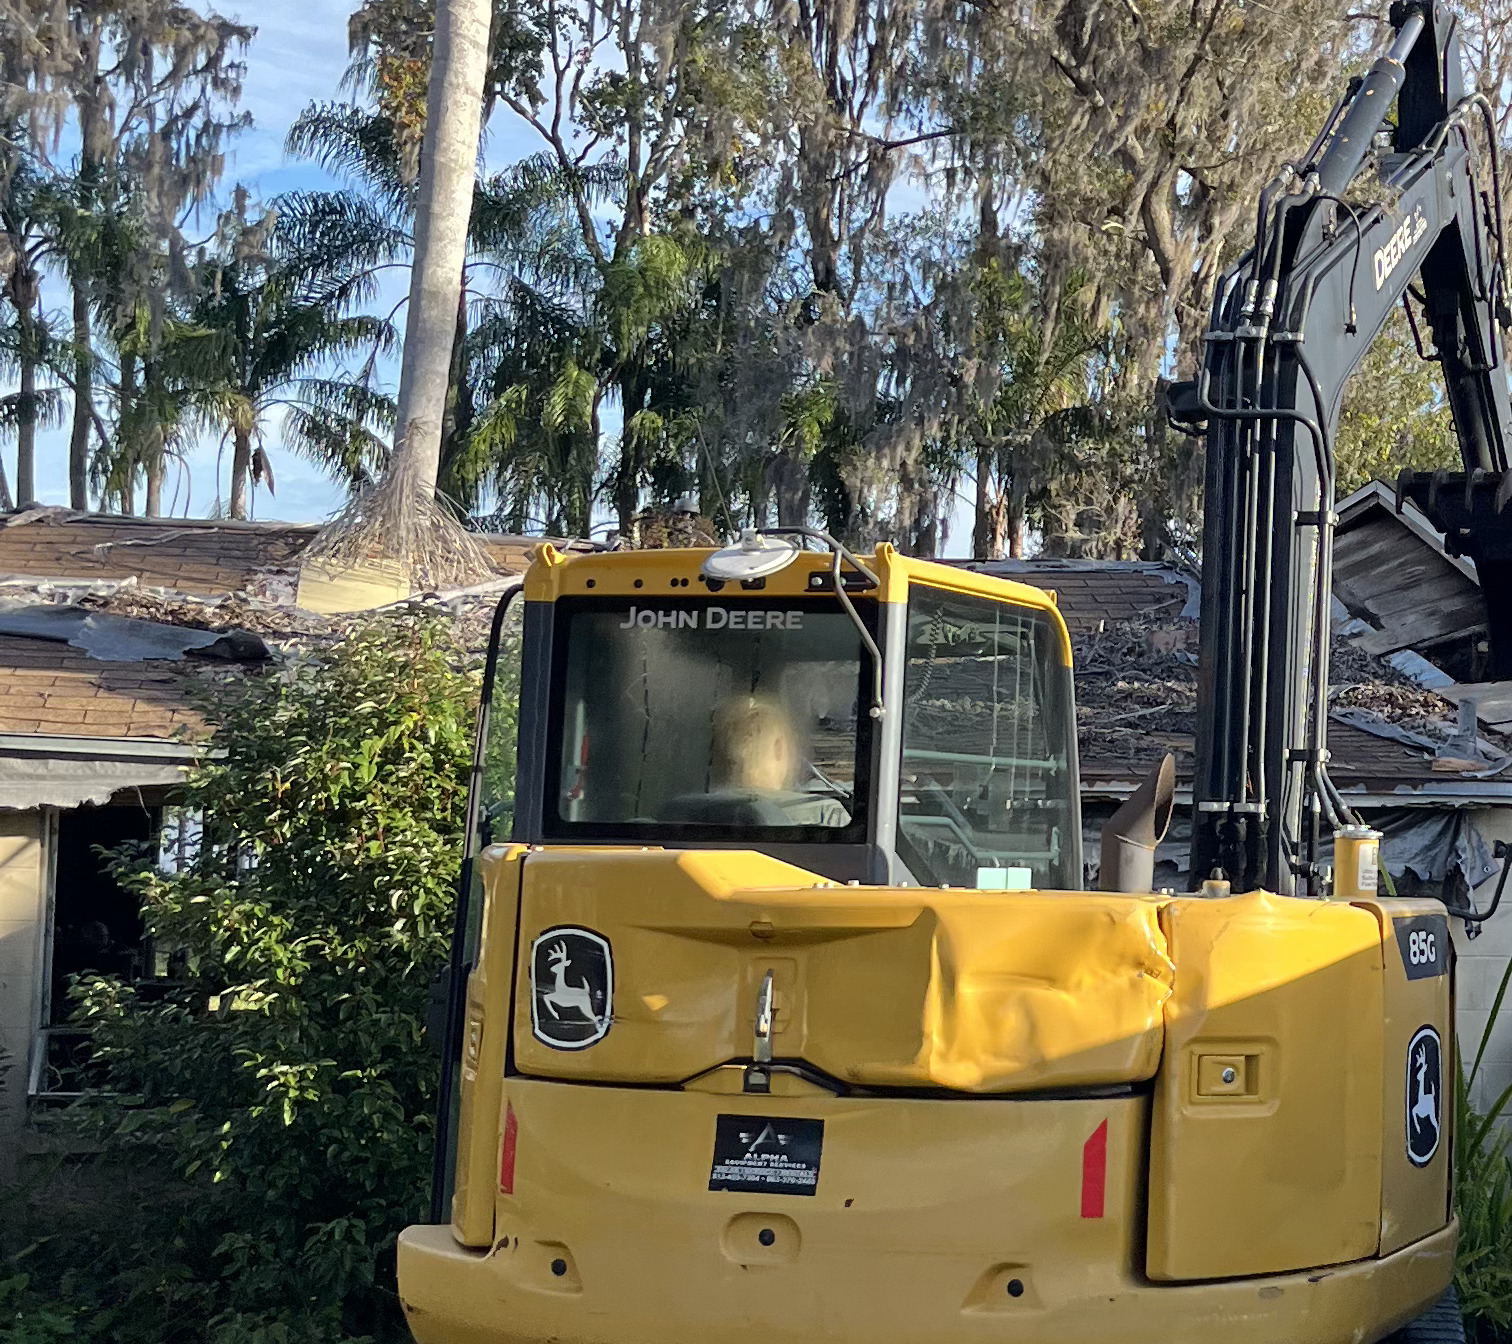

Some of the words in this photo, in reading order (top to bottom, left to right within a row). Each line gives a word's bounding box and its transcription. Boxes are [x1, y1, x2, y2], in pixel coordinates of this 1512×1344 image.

[1374, 214, 1412, 291] DEERE
[620, 606, 699, 630] JOHN
[706, 606, 804, 630] DEERE
[1409, 930, 1436, 965] 85G
